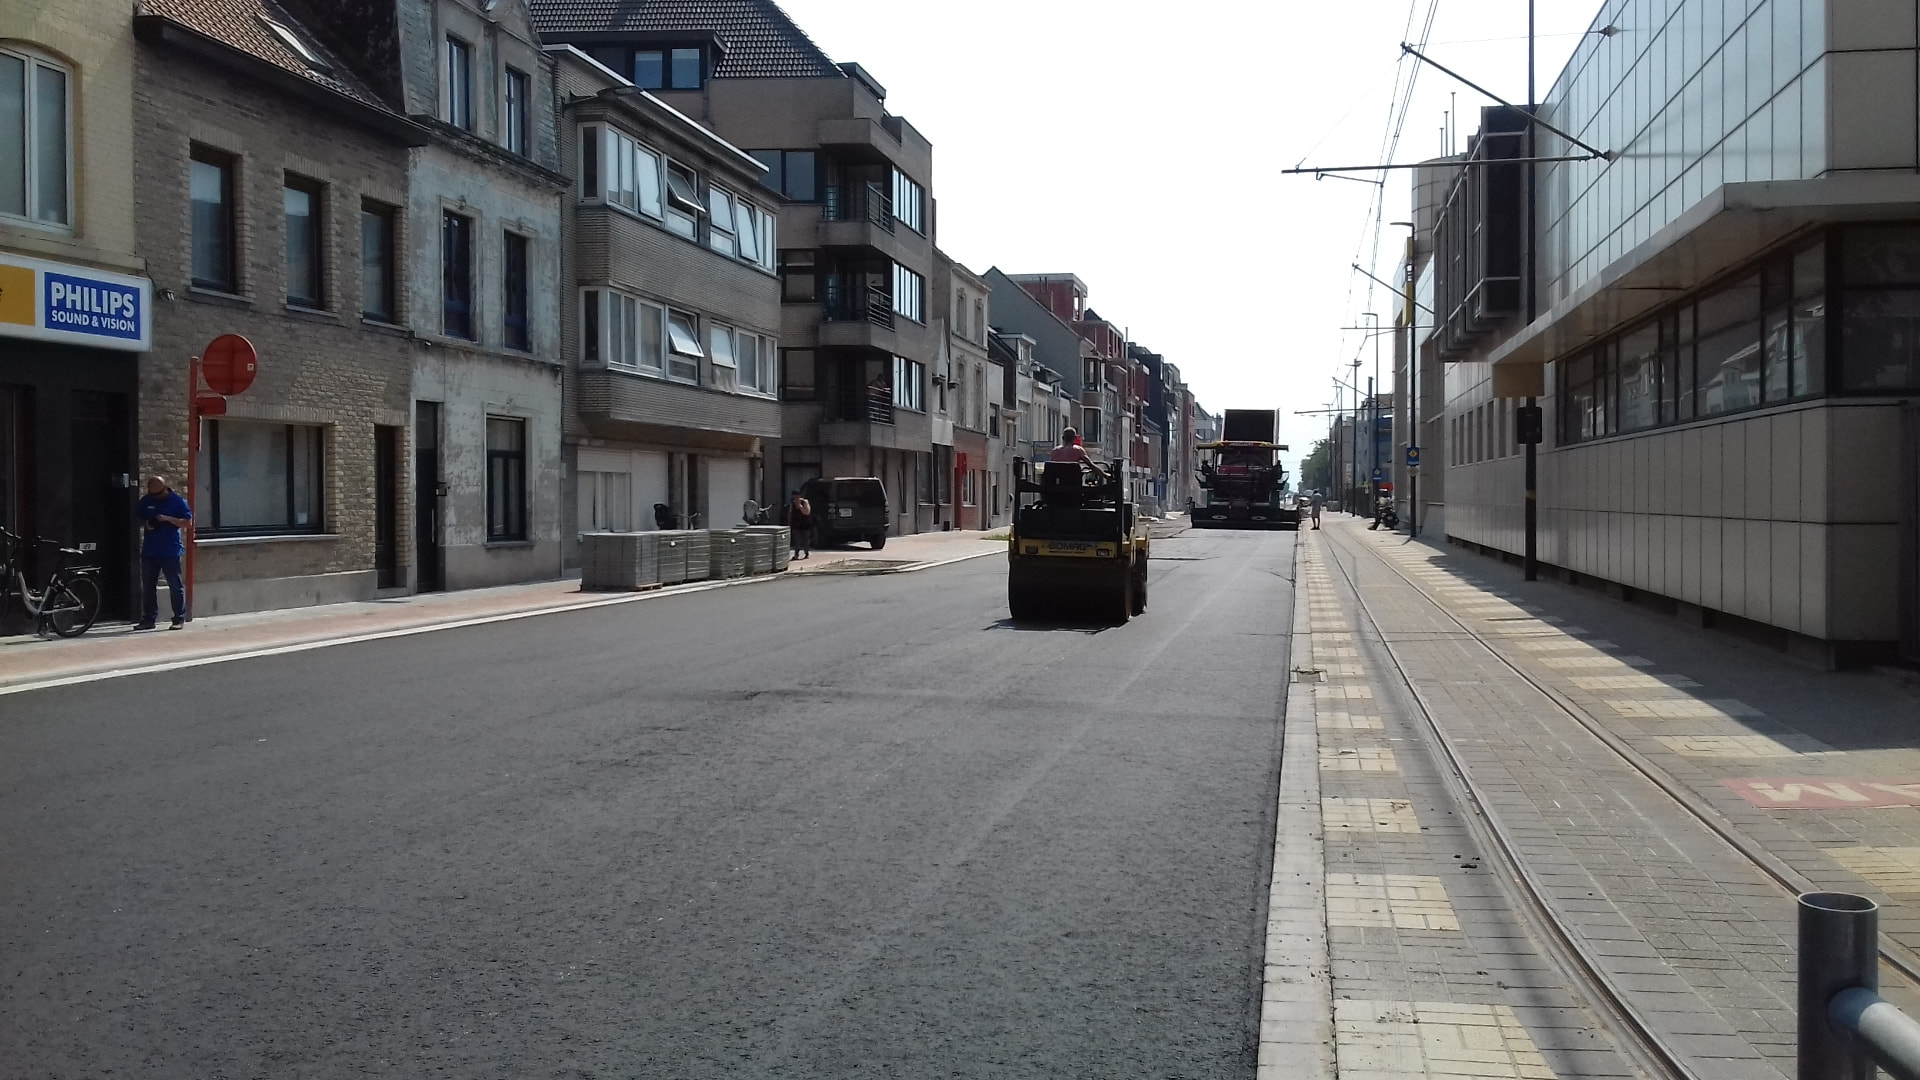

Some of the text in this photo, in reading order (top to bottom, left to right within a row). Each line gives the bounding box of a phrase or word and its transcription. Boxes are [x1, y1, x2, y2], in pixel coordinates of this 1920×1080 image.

[51, 281, 135, 318] PHILIPS
[51, 310, 136, 332] SOUND & VISION
